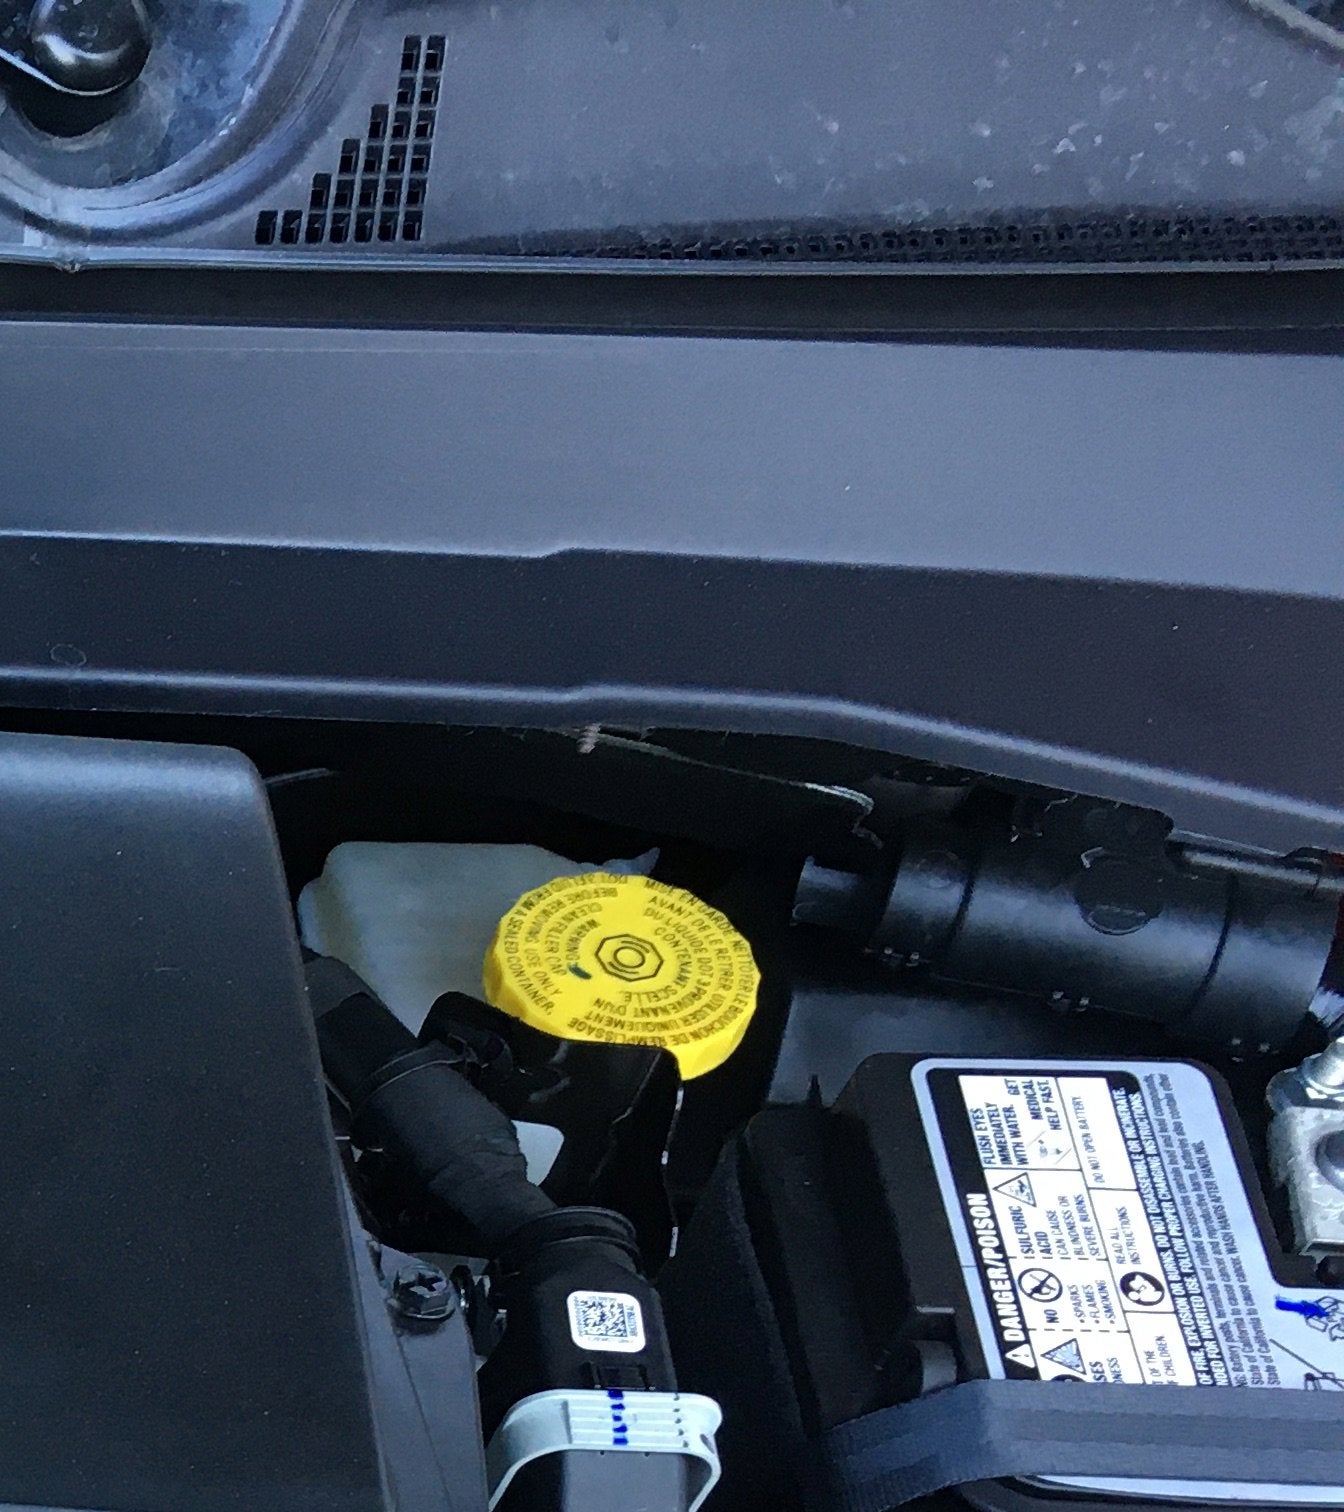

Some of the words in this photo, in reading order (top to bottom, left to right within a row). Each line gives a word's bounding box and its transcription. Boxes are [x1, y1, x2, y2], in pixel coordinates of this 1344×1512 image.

[519, 886, 553, 911] FROM
[562, 887, 618, 904] BEFORE
[647, 894, 693, 919] AVANT
[678, 892, 699, 906] EN
[513, 908, 528, 917] A
[558, 901, 604, 924] CLEAN
[643, 906, 665, 921] DU
[690, 917, 712, 932] DE
[696, 903, 738, 935] GARDE
[503, 915, 524, 953] SEALED
[543, 919, 568, 953] FILLER
[662, 916, 709, 953] LIQUIDE
[704, 932, 724, 945] LE
[524, 947, 543, 968] USE
[544, 956, 569, 977] CAP
[652, 925, 693, 988] CONTENANT
[696, 957, 713, 977] DOT
[728, 939, 755, 994] NETTOYER
[531, 970, 564, 997] ONLY
[695, 977, 712, 988] 3
[633, 985, 712, 1018] PROVENANT
[732, 992, 751, 1006] LE
[564, 1016, 669, 1048] REMPLISSAGE
[582, 1008, 682, 1032] UNIQUEMENT
[685, 1004, 749, 1042] BOUCHON
[668, 1033, 692, 1046] DE
[1003, 1078, 1020, 1095] GET
[1035, 1078, 1054, 1103] FAST.
[1020, 1079, 1043, 1120] MEDICAL
[1161, 1092, 1182, 1119] contain
[968, 1107, 988, 1131] EYES
[1000, 1103, 1022, 1139] WATER.
[1043, 1106, 1062, 1130] HELP
[1168, 1120, 1187, 1136] also
[984, 1101, 1013, 1165] IMMEDIATELY
[1080, 1132, 1097, 1152] OPEN
[1158, 1134, 1174, 1147] and
[976, 1134, 997, 1165] FLUSH
[1011, 1141, 1029, 1165] WITH
[1125, 1139, 1143, 1152] OR
[1174, 1137, 1197, 1170] Batteries
[1086, 1155, 1101, 1170] NOT
[1091, 1172, 1105, 1183] DO
[1130, 1153, 1161, 1213] DISASSEMBLE
[1145, 1157, 1172, 1199] CHARGING
[1168, 1166, 1188, 1193] contain
[1056, 1195, 1070, 1207] OR
[1203, 1180, 1223, 1203] AFTER
[1072, 1194, 1090, 1222] BURNS
[1159, 1200, 1184, 1236] PROPER
[1177, 1194, 1203, 1238] accessories
[1192, 1193, 1220, 1239] reproductive
[1210, 1204, 1232, 1230] HANDS
[1008, 1205, 1034, 1254] SULFURIC
[1045, 1209, 1063, 1235] CAUSE
[1060, 1209, 1085, 1256] BLINDNESS
[1106, 1225, 1120, 1240] ALL
[1148, 1214, 1167, 1233] NOT
[1033, 1230, 1052, 1255] ACID
[1053, 1237, 1069, 1255] CAN
[1081, 1225, 1101, 1256] SEVERE
[1114, 1205, 1142, 1264] INSTRUCTIONS
[1154, 1234, 1171, 1247] DO
[1219, 1231, 1240, 1254] WASH
[1111, 1242, 1127, 1264] READ
[1169, 1236, 1195, 1272] FOLLOW
[1191, 1239, 1211, 1265] related
[1206, 1240, 1223, 1255] and
[964, 1192, 1026, 1343] DANGER/POISON
[1199, 1267, 1216, 1281] and
[1213, 1257, 1231, 1282] cancer
[1094, 1279, 1116, 1319] SMOKING
[1168, 1282, 1186, 1295] OR
[1221, 1283, 1240, 1306] cause
[1237, 1284, 1256, 1306] cause
[1066, 1284, 1086, 1318] SPARKS
[1080, 1284, 1101, 1318] FLAMES
[1228, 1307, 1243, 1315] to
[1243, 1307, 1259, 1315] to
[1042, 1308, 1060, 1324] NO
[1173, 1297, 1202, 1346] EXPLOSION
[1188, 1294, 1215, 1339] INVERTED
[1230, 1317, 1255, 1353] California
[1246, 1316, 1271, 1354] California
[1142, 1349, 1158, 1363] THE
[1202, 1340, 1221, 1358] FOR
[1242, 1354, 1258, 1362] of
[1258, 1354, 1274, 1363] of
[1087, 1360, 1108, 1383] SES
[1147, 1367, 1162, 1376] OF
[1196, 1371, 1214, 1384] OF
[1208, 1359, 1230, 1386] NDED
[1245, 1364, 1265, 1384] State
[1261, 1364, 1281, 1385] State
